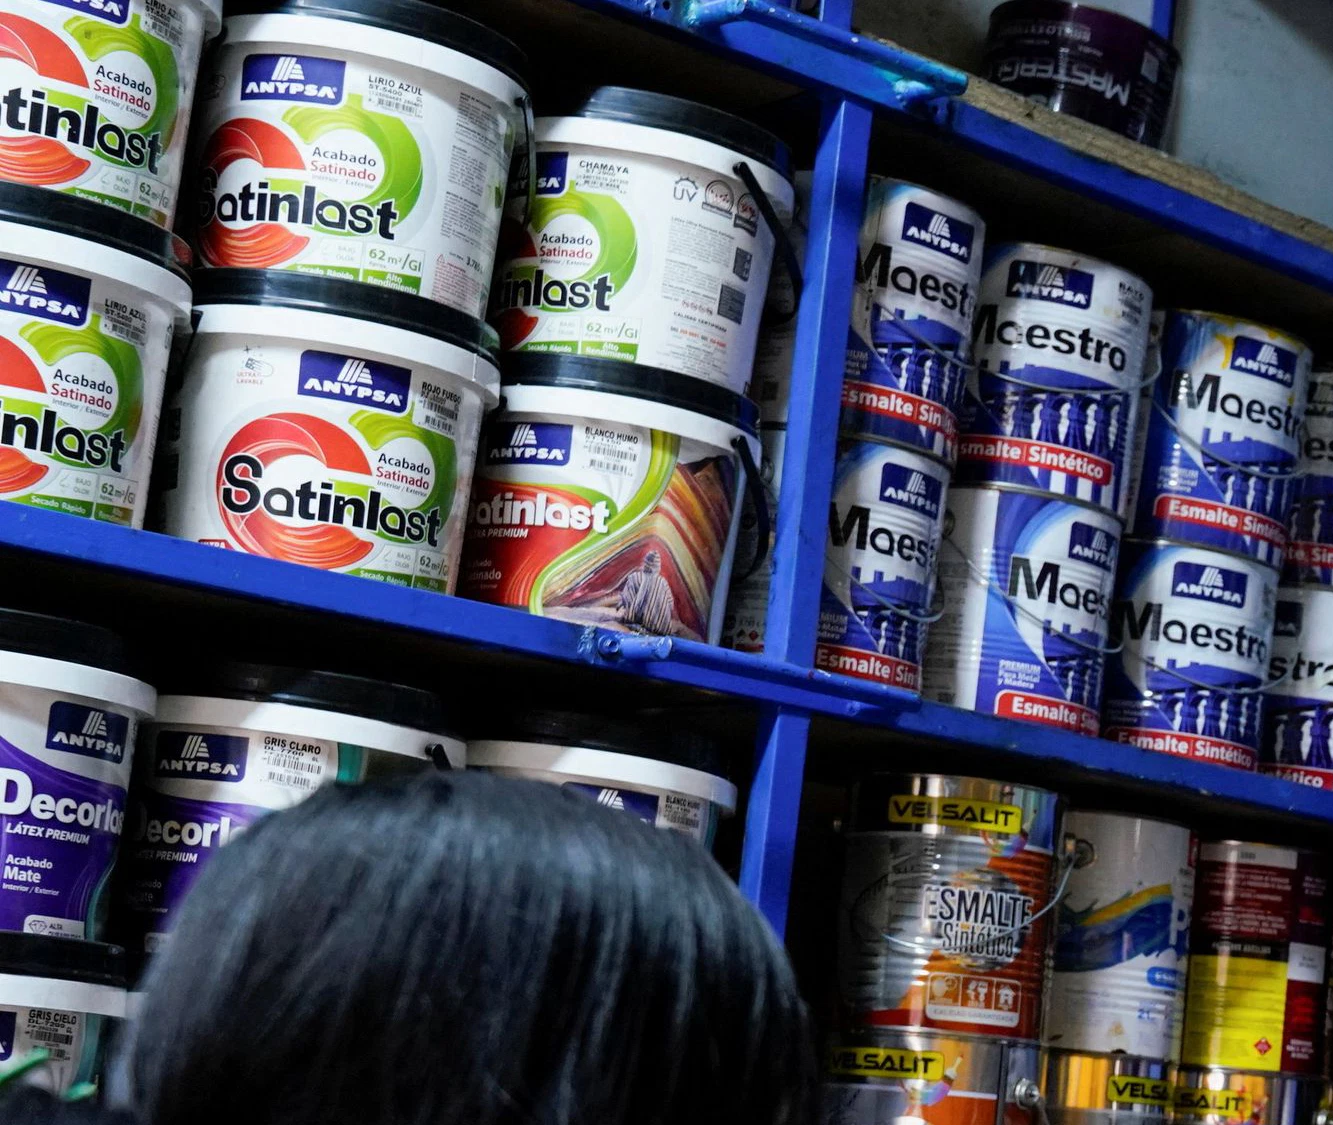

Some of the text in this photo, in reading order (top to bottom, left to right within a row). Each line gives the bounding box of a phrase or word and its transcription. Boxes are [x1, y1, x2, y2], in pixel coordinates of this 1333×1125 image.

[96, 65, 152, 97] Acabado
[245, 81, 335, 100] ANYPSA
[368, 74, 423, 96] LIRIO AZUL
[94, 79, 151, 111] Satinado
[312, 146, 377, 168] Acabado
[579, 160, 630, 175] CHAMAYA
[310, 160, 377, 182] Satinado
[673, 185, 698, 202] UV
[541, 233, 593, 247] Acabado
[539, 246, 593, 260] Satinado
[53, 368, 113, 395] Acabado
[303, 377, 402, 407] ANYPSA
[422, 381, 443, 396] ROJO
[51, 383, 112, 411] Satinado
[585, 426, 639, 444] BLANCO HUMO
[378, 452, 430, 476] Acabado
[490, 447, 565, 460] ANYPSA
[1029, 443, 1104, 479] Sintético
[376, 466, 430, 491] Satinado
[222, 453, 440, 547] Satinlast
[487, 528, 528, 539] PREMIUM
[52, 731, 121, 757] ANYPSA
[263, 735, 322, 755] GRIS CLARO
[1194, 738, 1253, 769] Sintético
[159, 760, 238, 777] ANYPSA
[890, 800, 1018, 828] VELSALIT
[5, 820, 90, 845] LÁTEX PREMIUM
[5, 853, 53, 870] Acabado
[3, 865, 42, 884] Mate
[29, 1009, 51, 1021] GRIS
